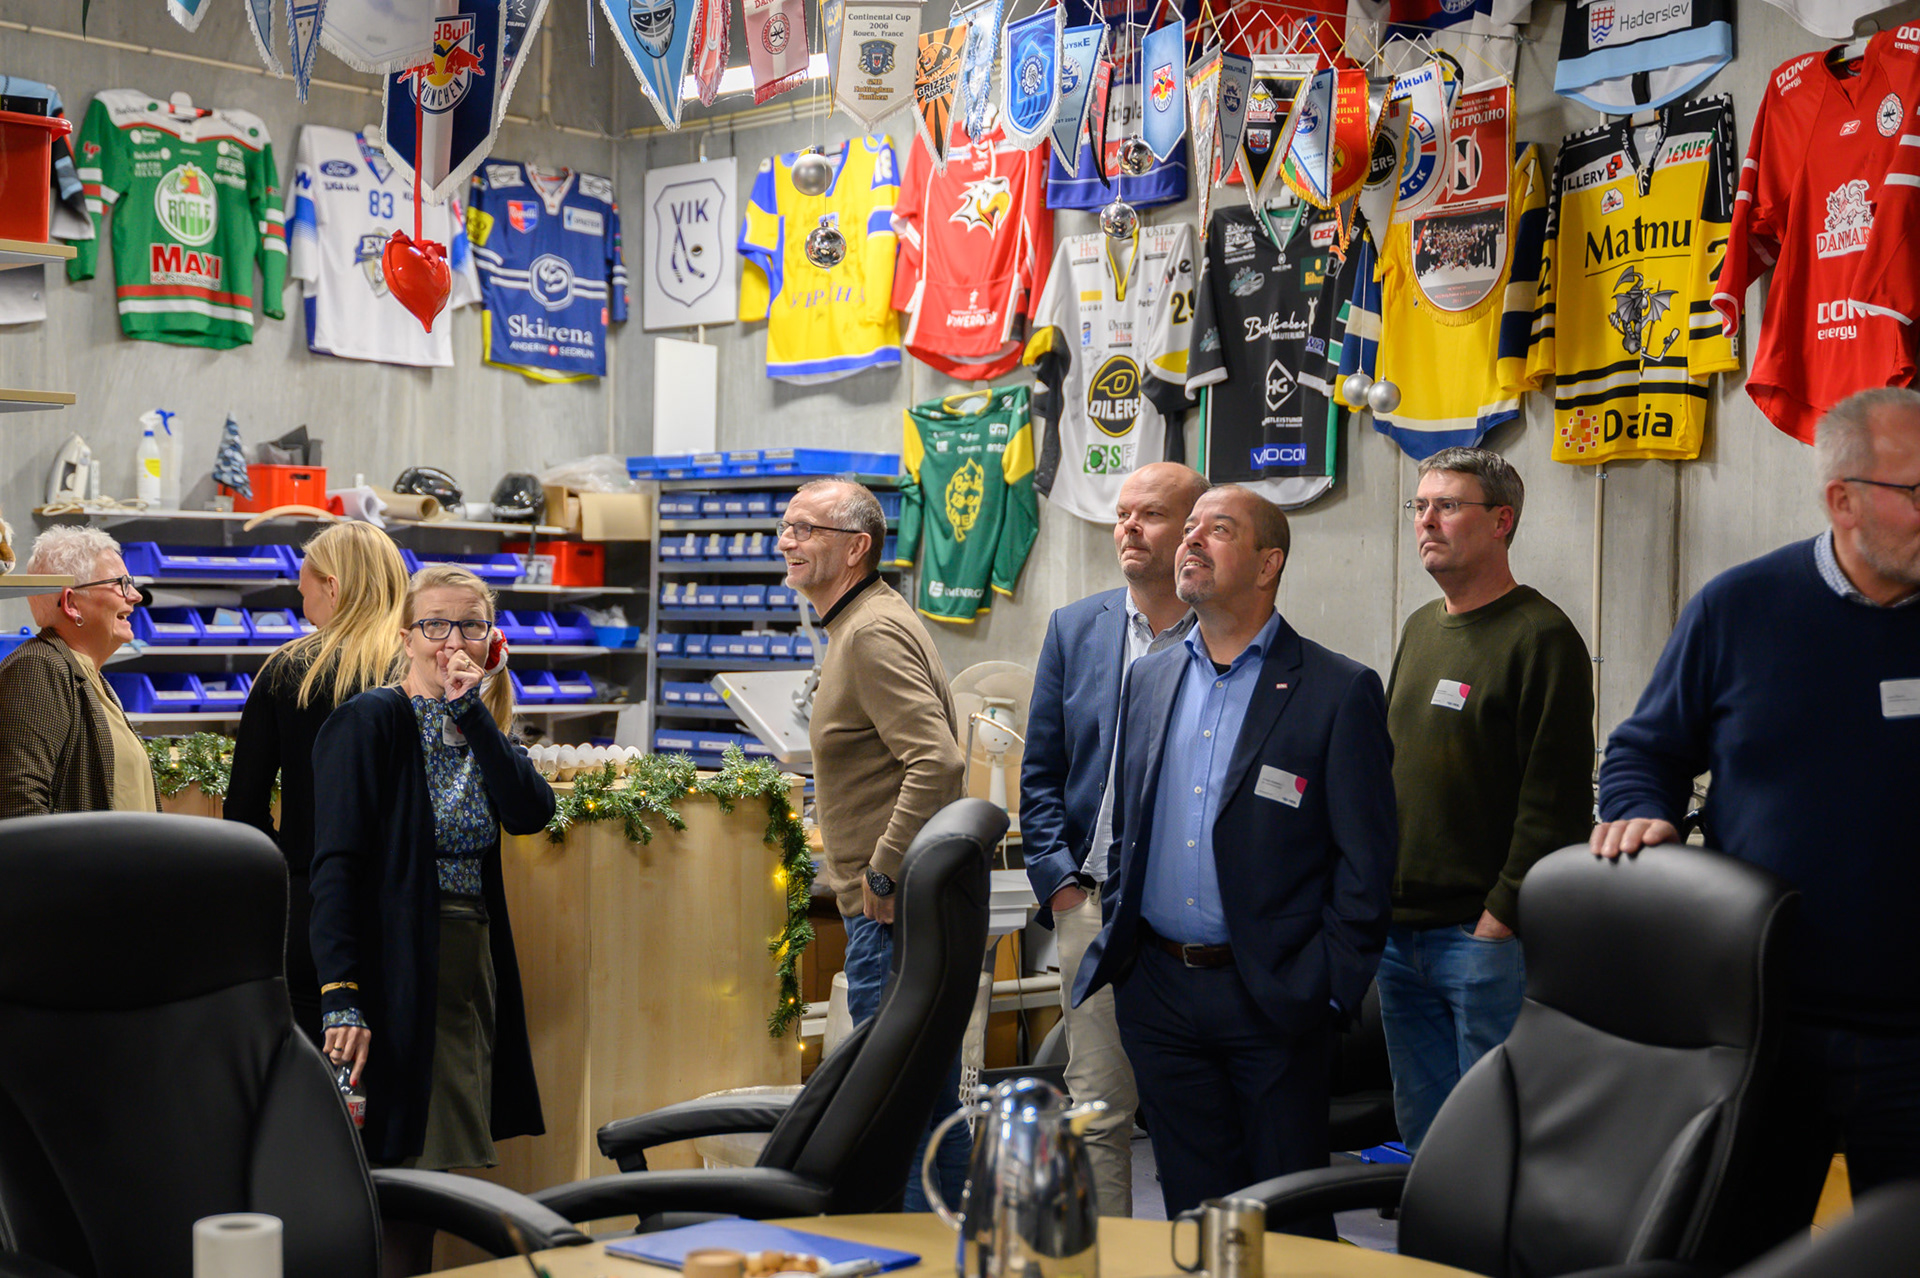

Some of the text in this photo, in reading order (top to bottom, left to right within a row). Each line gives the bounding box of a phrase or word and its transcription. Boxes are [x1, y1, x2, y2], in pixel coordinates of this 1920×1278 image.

[848, 13, 911, 22] Continental Cup
[869, 22, 889, 30] 2006
[1620, 2, 1690, 32] Haderslev
[1064, 37, 1091, 49] JYSKE
[420, 77, 464, 107] MÜNCHEN
[917, 72, 957, 97] GRIZZLY
[924, 84, 952, 101] ADAMS
[1451, 107, 1505, 130] Н-ГРОДНО
[1563, 169, 1605, 192] ILLERY
[369, 190, 394, 219] 83
[671, 198, 708, 224] VIK
[362, 239, 385, 254] EV
[1818, 227, 1872, 253] DANMAR
[1267, 376, 1288, 395] HG
[1088, 398, 1140, 420] OILERS
